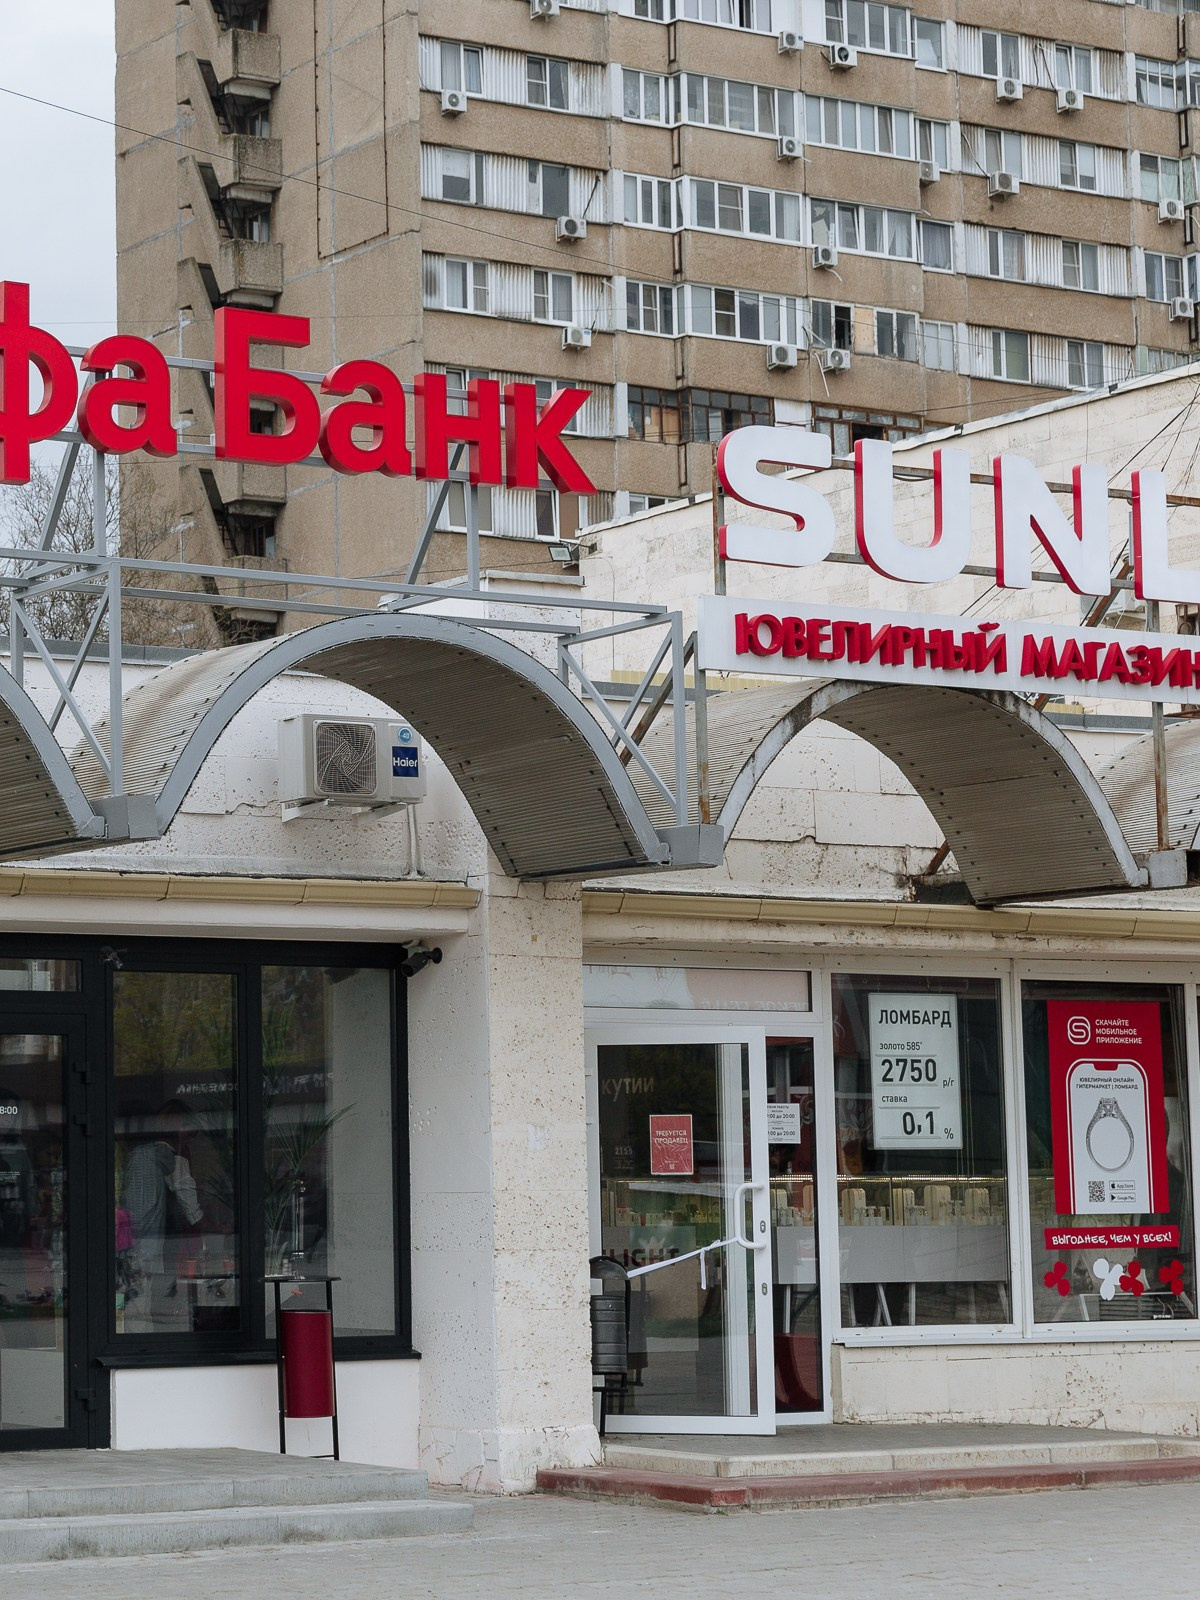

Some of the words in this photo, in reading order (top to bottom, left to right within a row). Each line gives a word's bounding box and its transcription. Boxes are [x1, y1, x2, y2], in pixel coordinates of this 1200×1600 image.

[213, 306, 597, 496] Банк
[717, 425, 1200, 604] SUNL
[734, 612, 1008, 675] ЮВЕЛИРНЫЙ
[1020, 634, 1200, 691] МАГАЗИН
[392, 757, 418, 768] Haier
[878, 1009, 952, 1028] ЛОМБАРД
[1095, 1018, 1130, 1027] СКАЧАЙТЕ
[1095, 1028, 1138, 1036] МОБИЛЬНОЕ
[879, 1043, 905, 1051] золото
[1096, 1037, 1143, 1045] ПРИЛОЖЕНИЕ
[881, 1058, 937, 1083] 2750
[881, 1095, 908, 1103] ставка
[902, 1111, 935, 1136] 0,1
[1051, 1234, 1108, 1245] ВЫГОДНЕЕ,
[1110, 1233, 1132, 1243] ЧЕМ
[1133, 1233, 1140, 1244] У
[1143, 1232, 1172, 1243] ВСЕХ!
